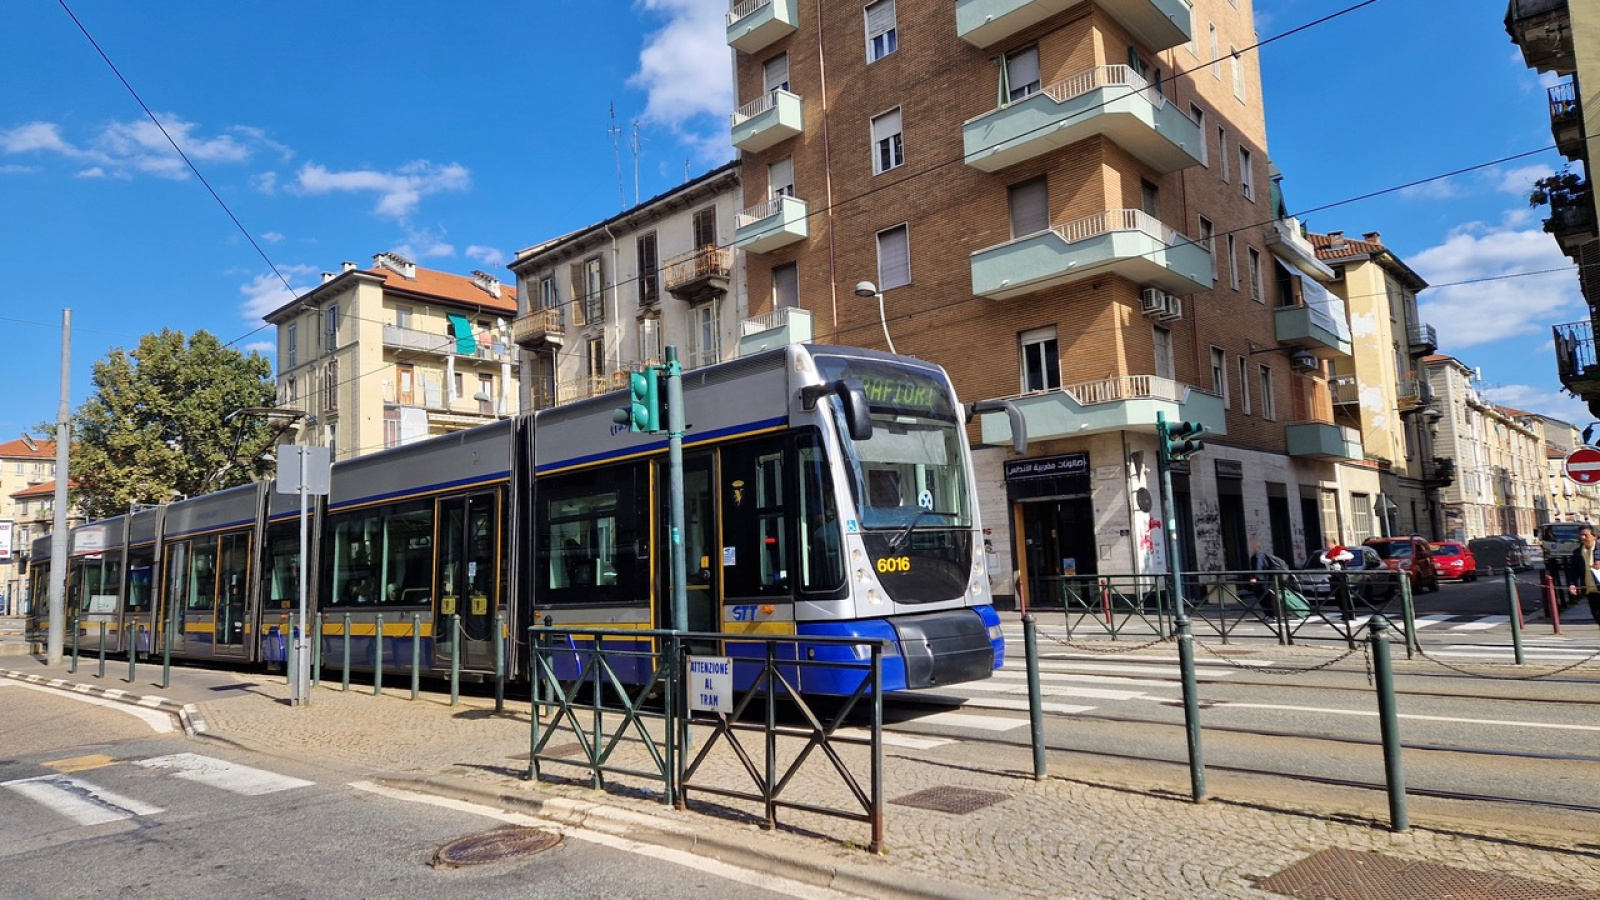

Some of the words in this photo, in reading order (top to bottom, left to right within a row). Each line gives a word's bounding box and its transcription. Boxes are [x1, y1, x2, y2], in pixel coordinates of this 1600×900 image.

[850, 374, 935, 406] RAFIORI
[877, 556, 911, 573] 6016
[690, 661, 728, 675] ATTENZIONE
[704, 678, 713, 690] AL
[700, 693, 718, 706] TRAM
